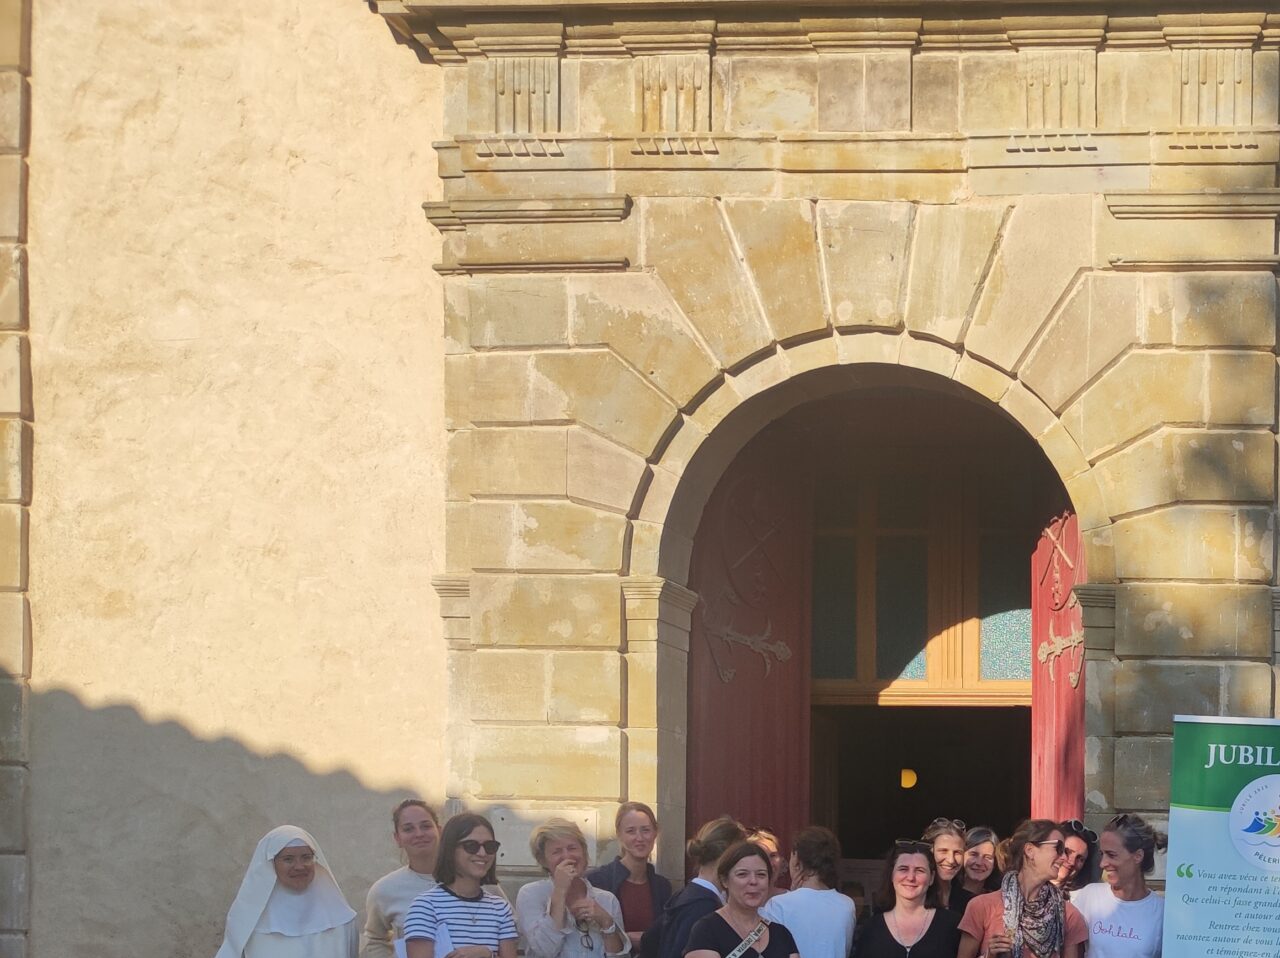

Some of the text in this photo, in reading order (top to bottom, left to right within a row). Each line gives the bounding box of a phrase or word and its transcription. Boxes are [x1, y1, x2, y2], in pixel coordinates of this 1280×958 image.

[1197, 869, 1216, 880] Vous
[1239, 873, 1257, 881] vécu
[1220, 884, 1263, 895] répondant
[1181, 893, 1199, 905] Que
[1201, 895, 1231, 905] celui-ci
[1232, 897, 1252, 908] fasse
[1208, 920, 1240, 931] Rentrez
[1242, 922, 1260, 932] chez
[1176, 933, 1210, 942] racontez
[1242, 935, 1252, 944] de
[1255, 938, 1273, 946] vous
[1216, 947, 1270, 958] témoignez-en
